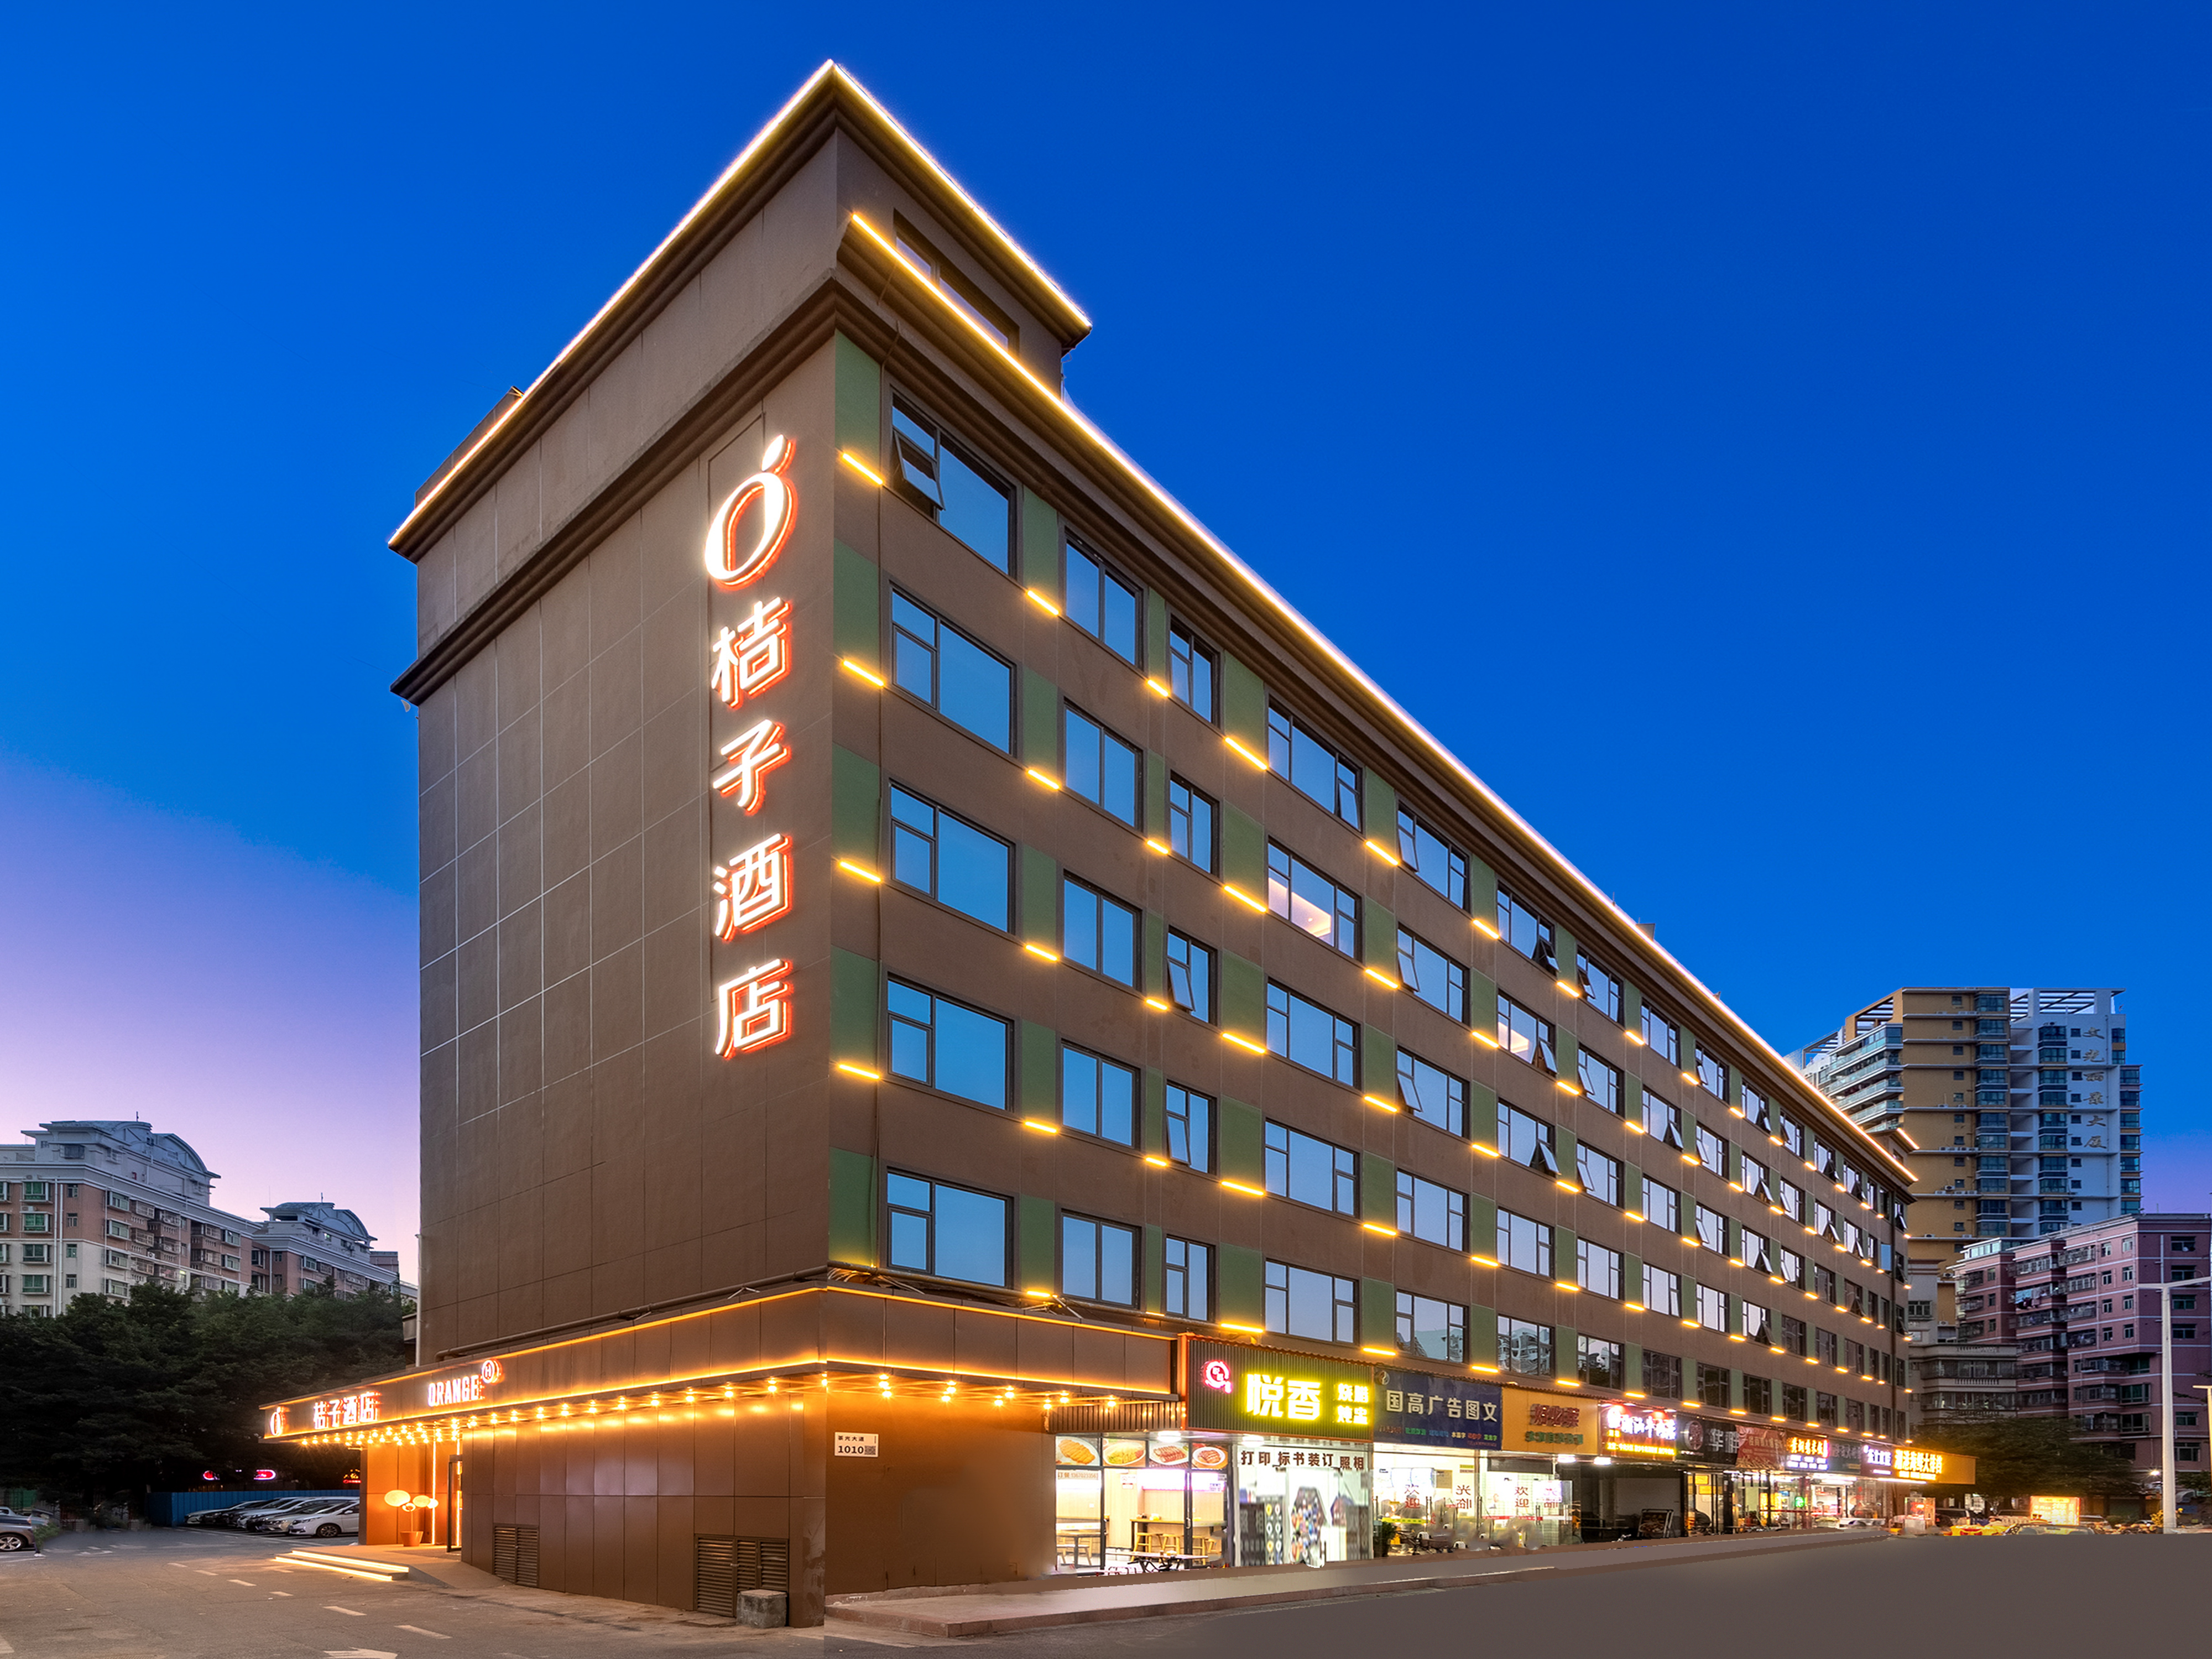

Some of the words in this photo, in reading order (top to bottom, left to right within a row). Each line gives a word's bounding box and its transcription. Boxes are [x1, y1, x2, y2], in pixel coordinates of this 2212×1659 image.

[711, 597, 791, 1057] 桔子酒店
[427, 1374, 479, 1407] ORANGE
[1247, 1374, 1321, 1421] 悦香
[1386, 1390, 1498, 1422] 国高广告图文
[314, 1392, 379, 1430] 桔子酒店
[838, 1446, 864, 1454] 1010
[1241, 1451, 1271, 1465] 打印
[1278, 1452, 1333, 1467] 标书装订
[1340, 1457, 1364, 1469] 照相
[1515, 1486, 1529, 1507] 欢迎
